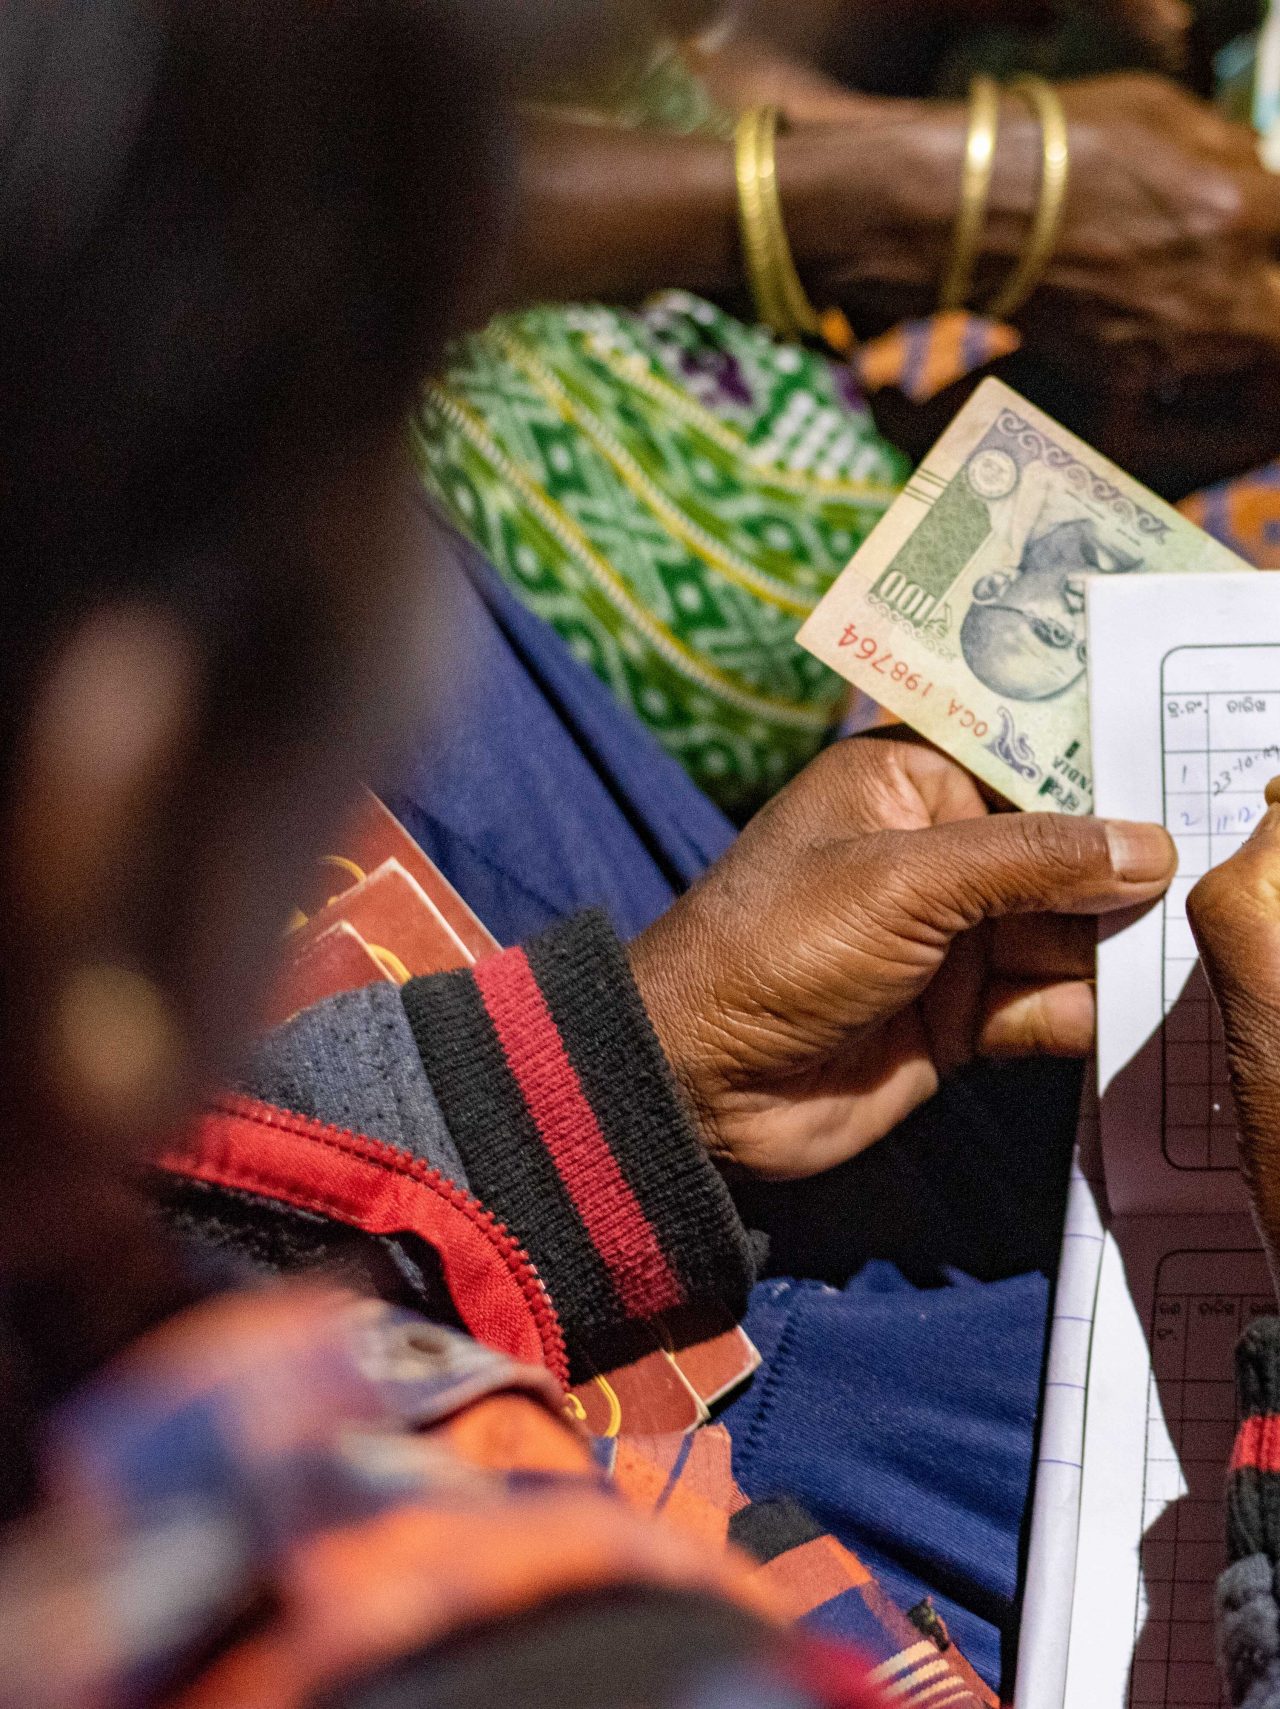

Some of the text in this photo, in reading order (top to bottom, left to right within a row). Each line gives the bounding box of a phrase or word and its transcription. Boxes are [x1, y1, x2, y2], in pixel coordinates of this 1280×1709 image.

[836, 622, 933, 697] 198764
[1226, 697, 1267, 714] ତାରିଖ
[1179, 811, 1198, 827] 2
